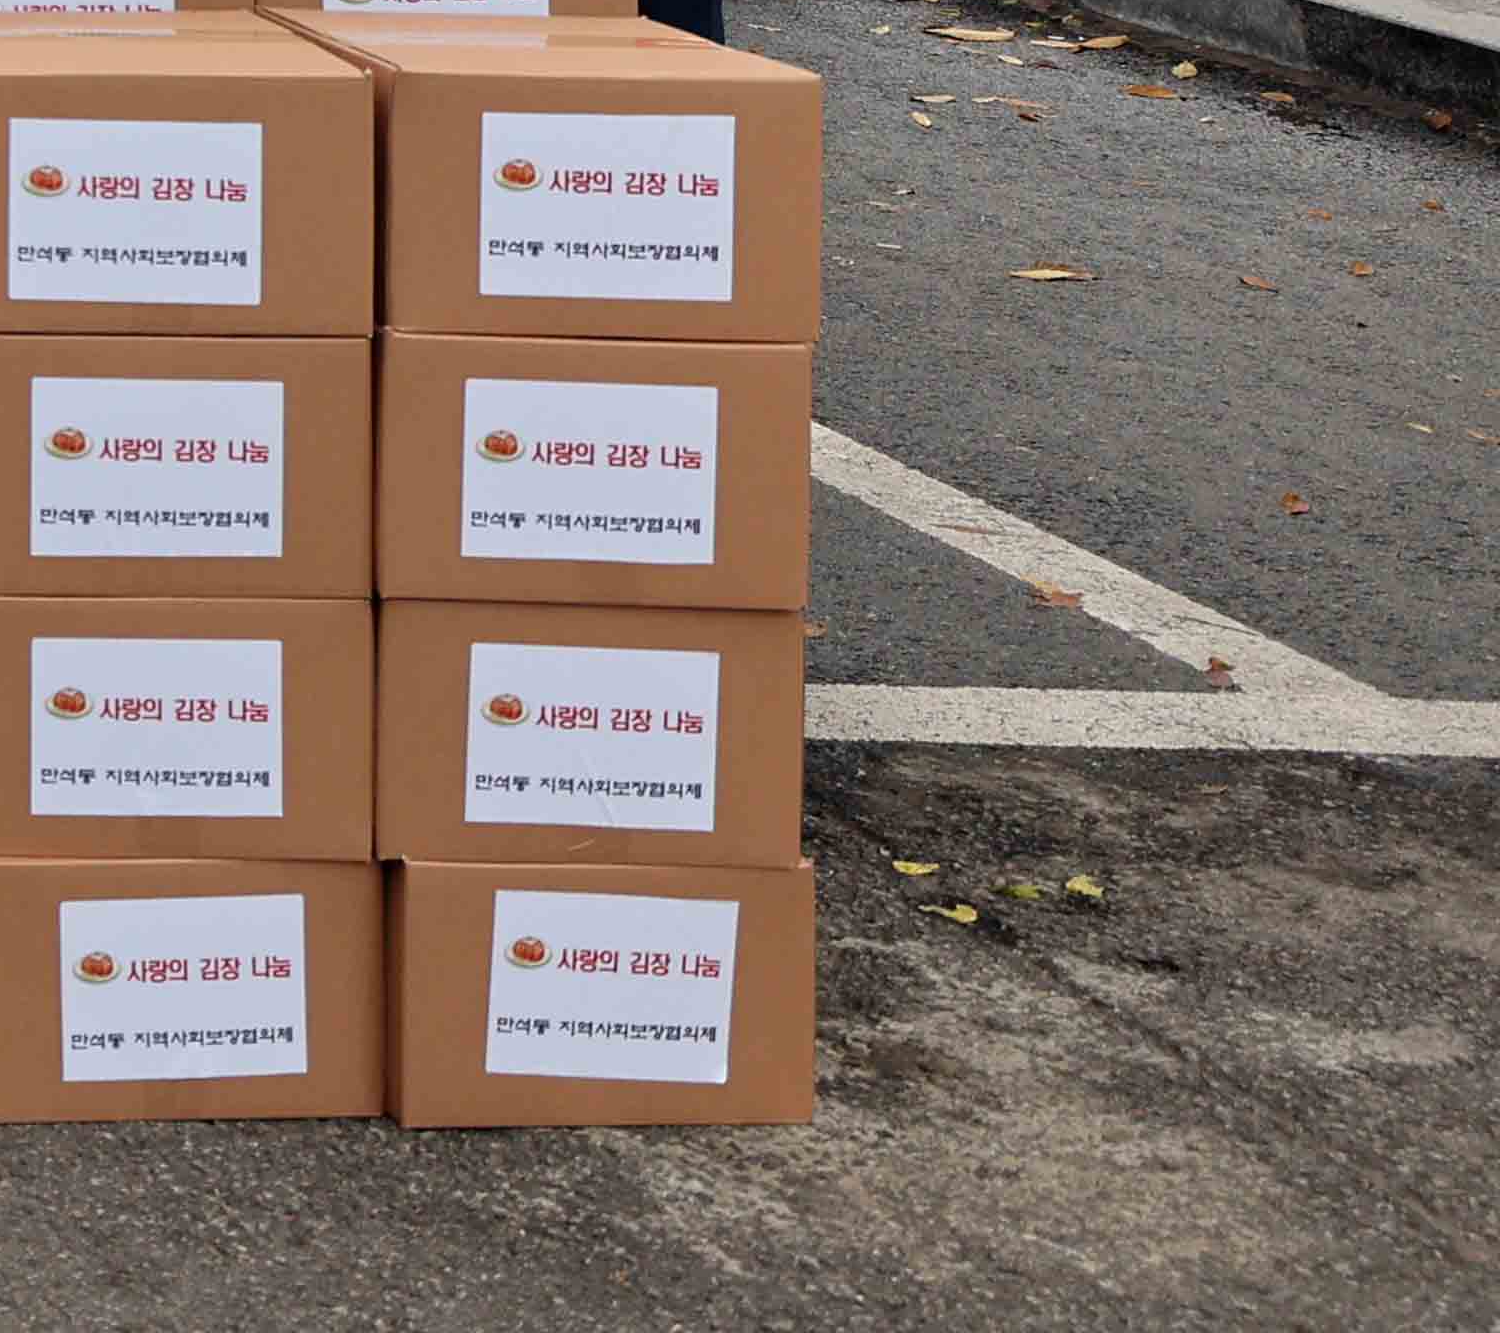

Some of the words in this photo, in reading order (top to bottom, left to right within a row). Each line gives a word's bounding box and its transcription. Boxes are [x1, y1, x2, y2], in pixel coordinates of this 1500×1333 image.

[547, 168, 614, 196] 사랑의
[623, 170, 669, 198] 김장
[676, 171, 721, 199] 나눔
[98, 436, 164, 464] 사랑의
[173, 438, 219, 465] 김장
[227, 438, 271, 465] 나눔
[534, 703, 600, 732] 사랑의
[609, 707, 654, 735] 김장
[661, 708, 705, 736] 나눔
[125, 957, 190, 985] 사랑의
[198, 955, 243, 983] 김장
[250, 954, 293, 980] 나눔
